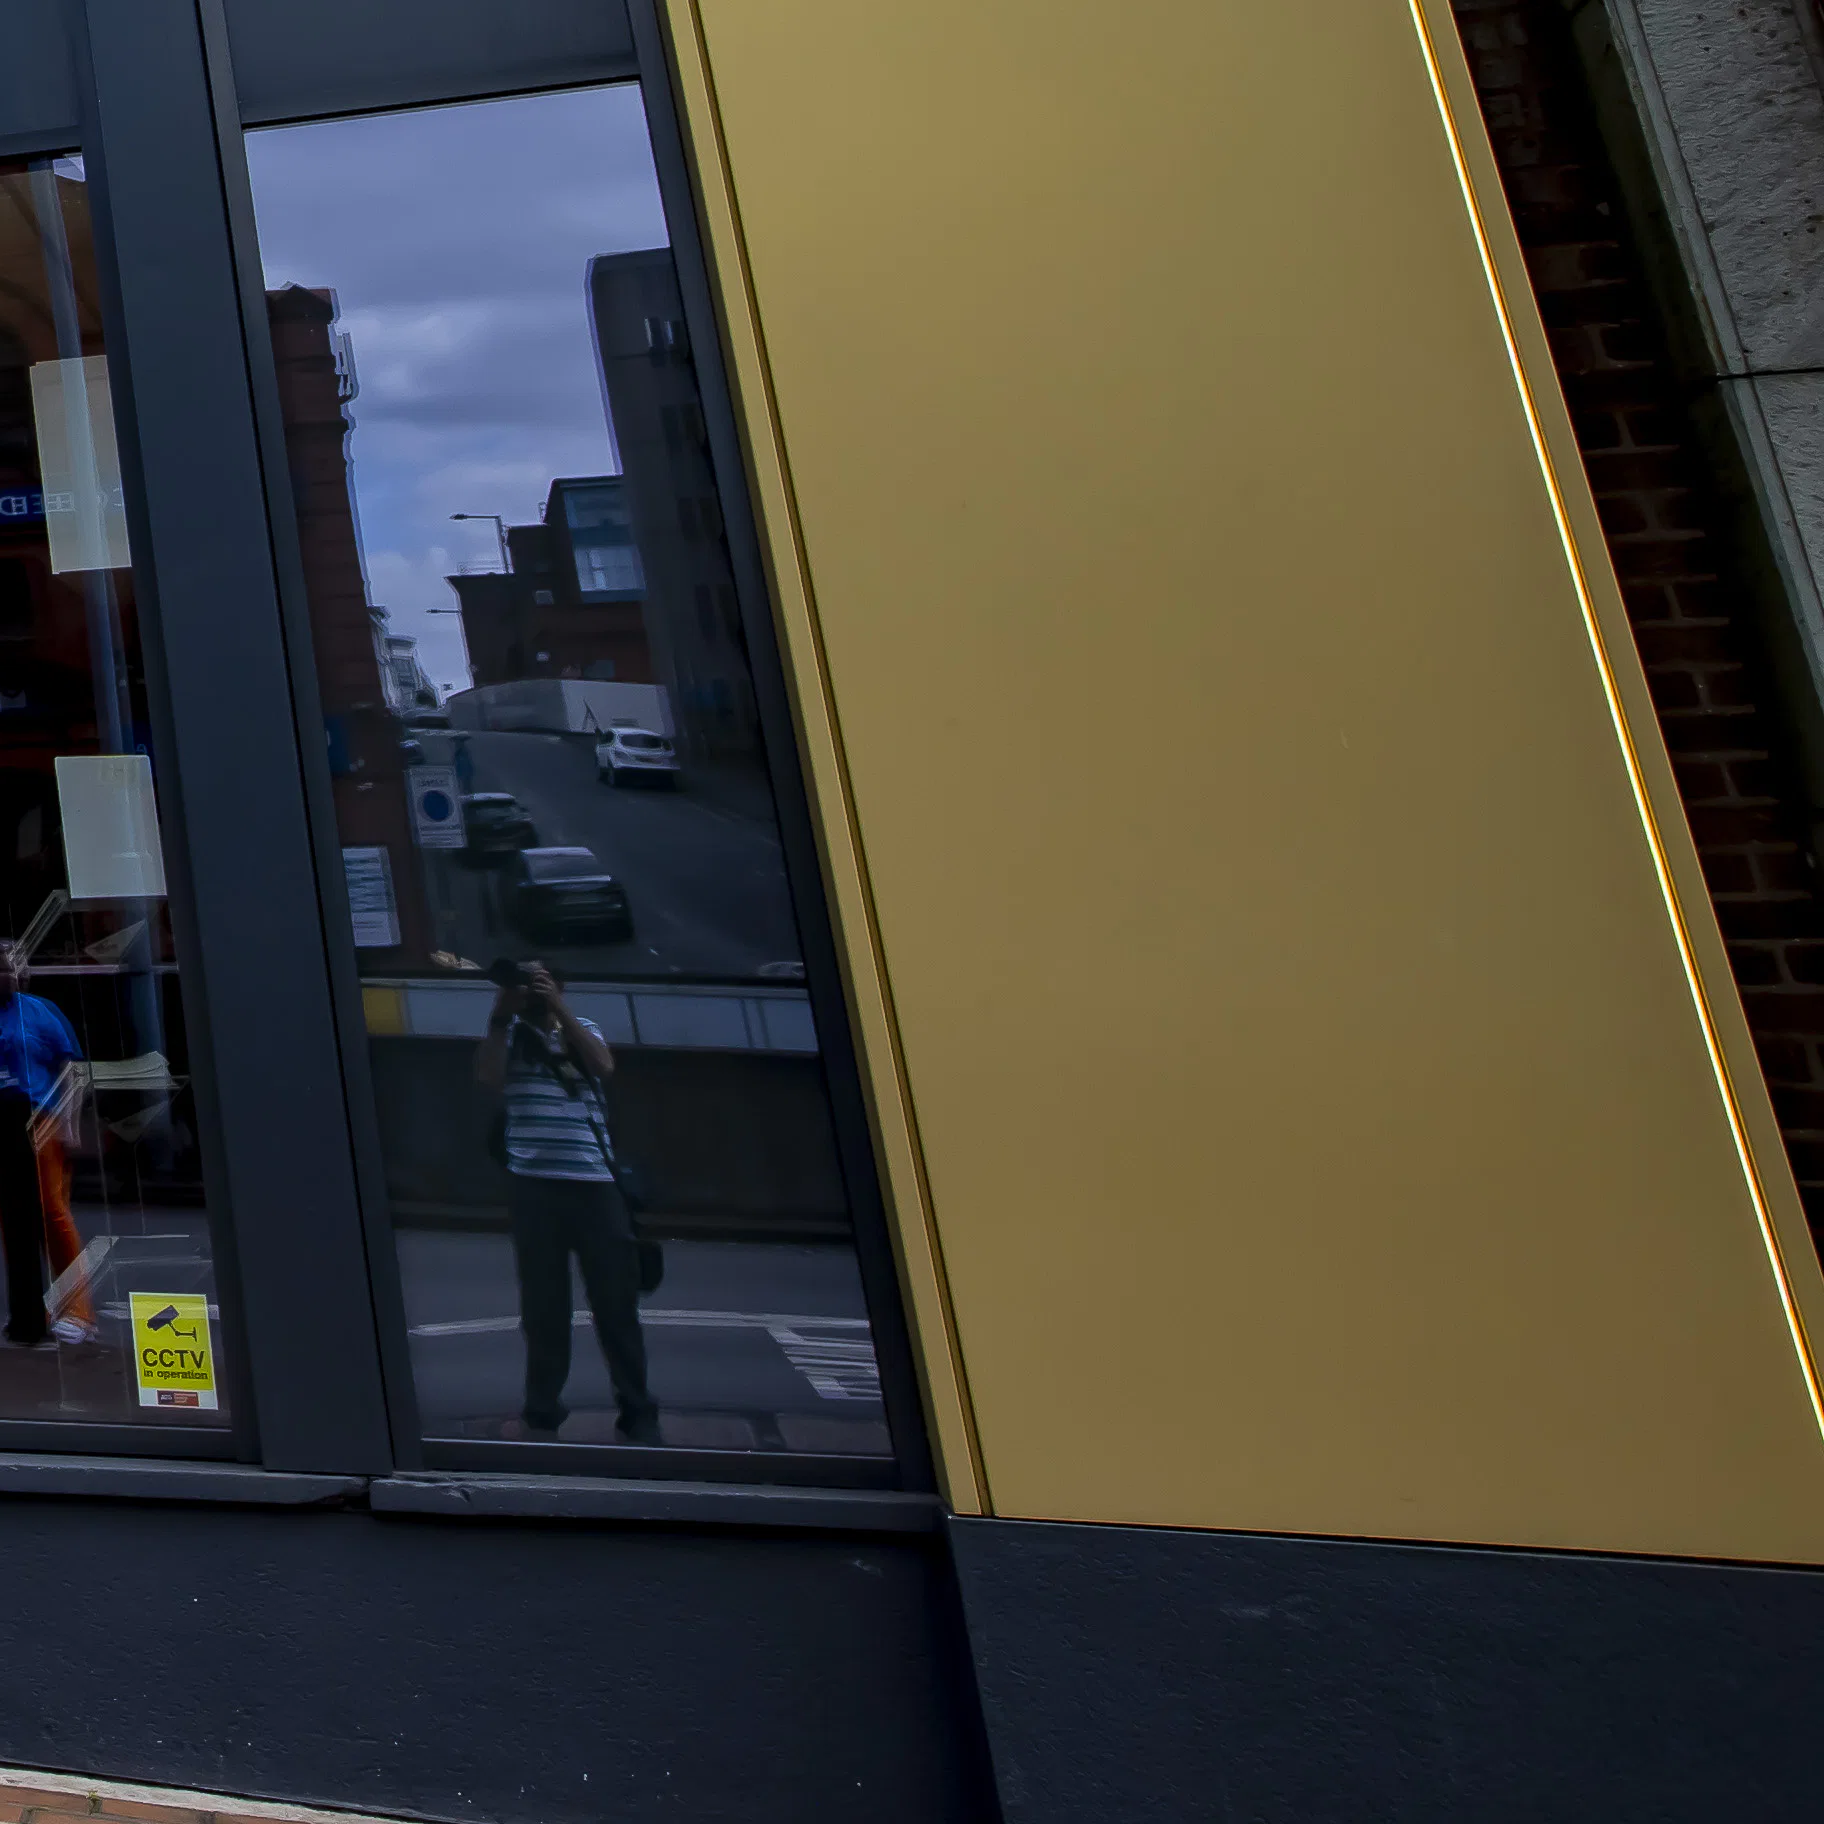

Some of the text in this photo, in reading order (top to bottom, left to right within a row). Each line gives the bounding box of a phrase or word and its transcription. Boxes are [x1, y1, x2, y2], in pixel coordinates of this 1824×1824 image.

[142, 1348, 205, 1369] CCTV
[143, 1369, 208, 1380] in operation
